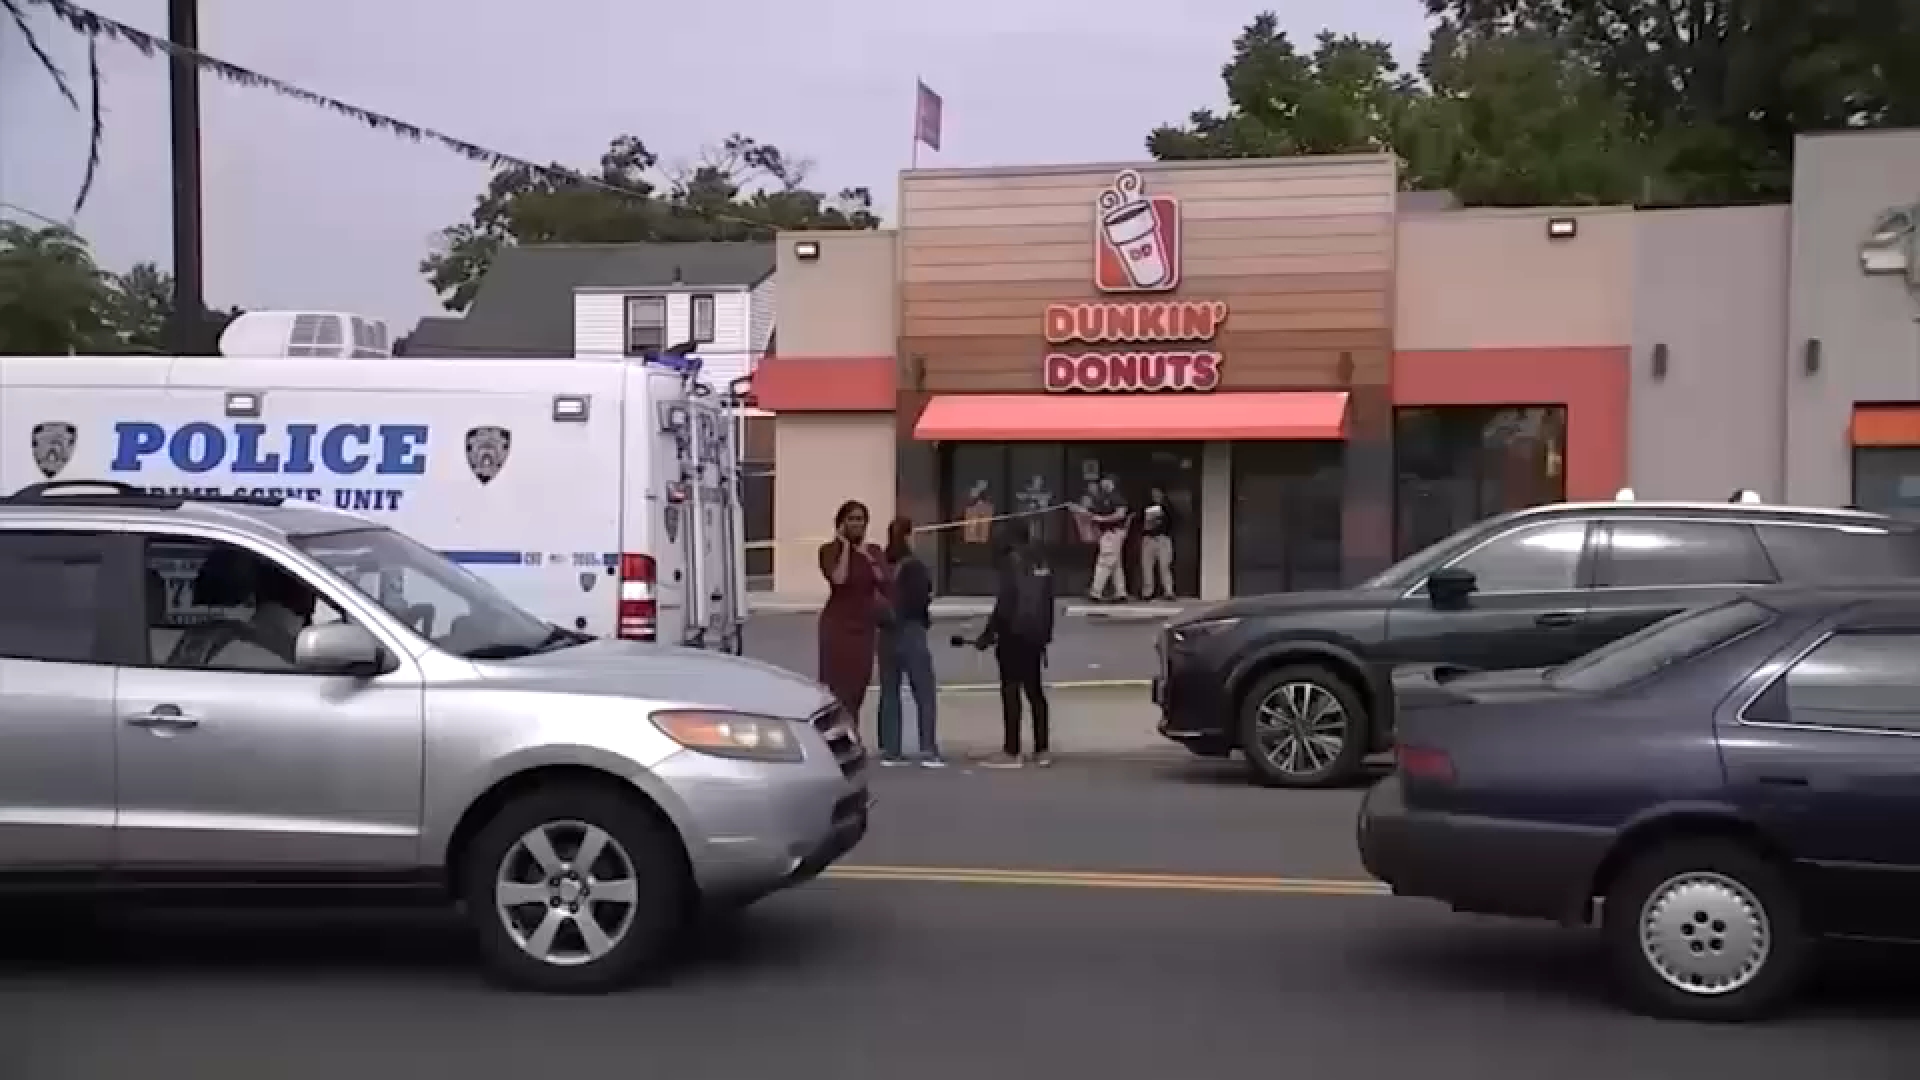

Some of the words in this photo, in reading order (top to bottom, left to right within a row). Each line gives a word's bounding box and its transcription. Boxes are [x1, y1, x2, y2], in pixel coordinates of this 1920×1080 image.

[1047, 302, 1227, 340] DUNKIN'
[1047, 353, 1219, 390] DONUTS
[111, 421, 429, 475] POLICE
[335, 488, 402, 510] UNIT
